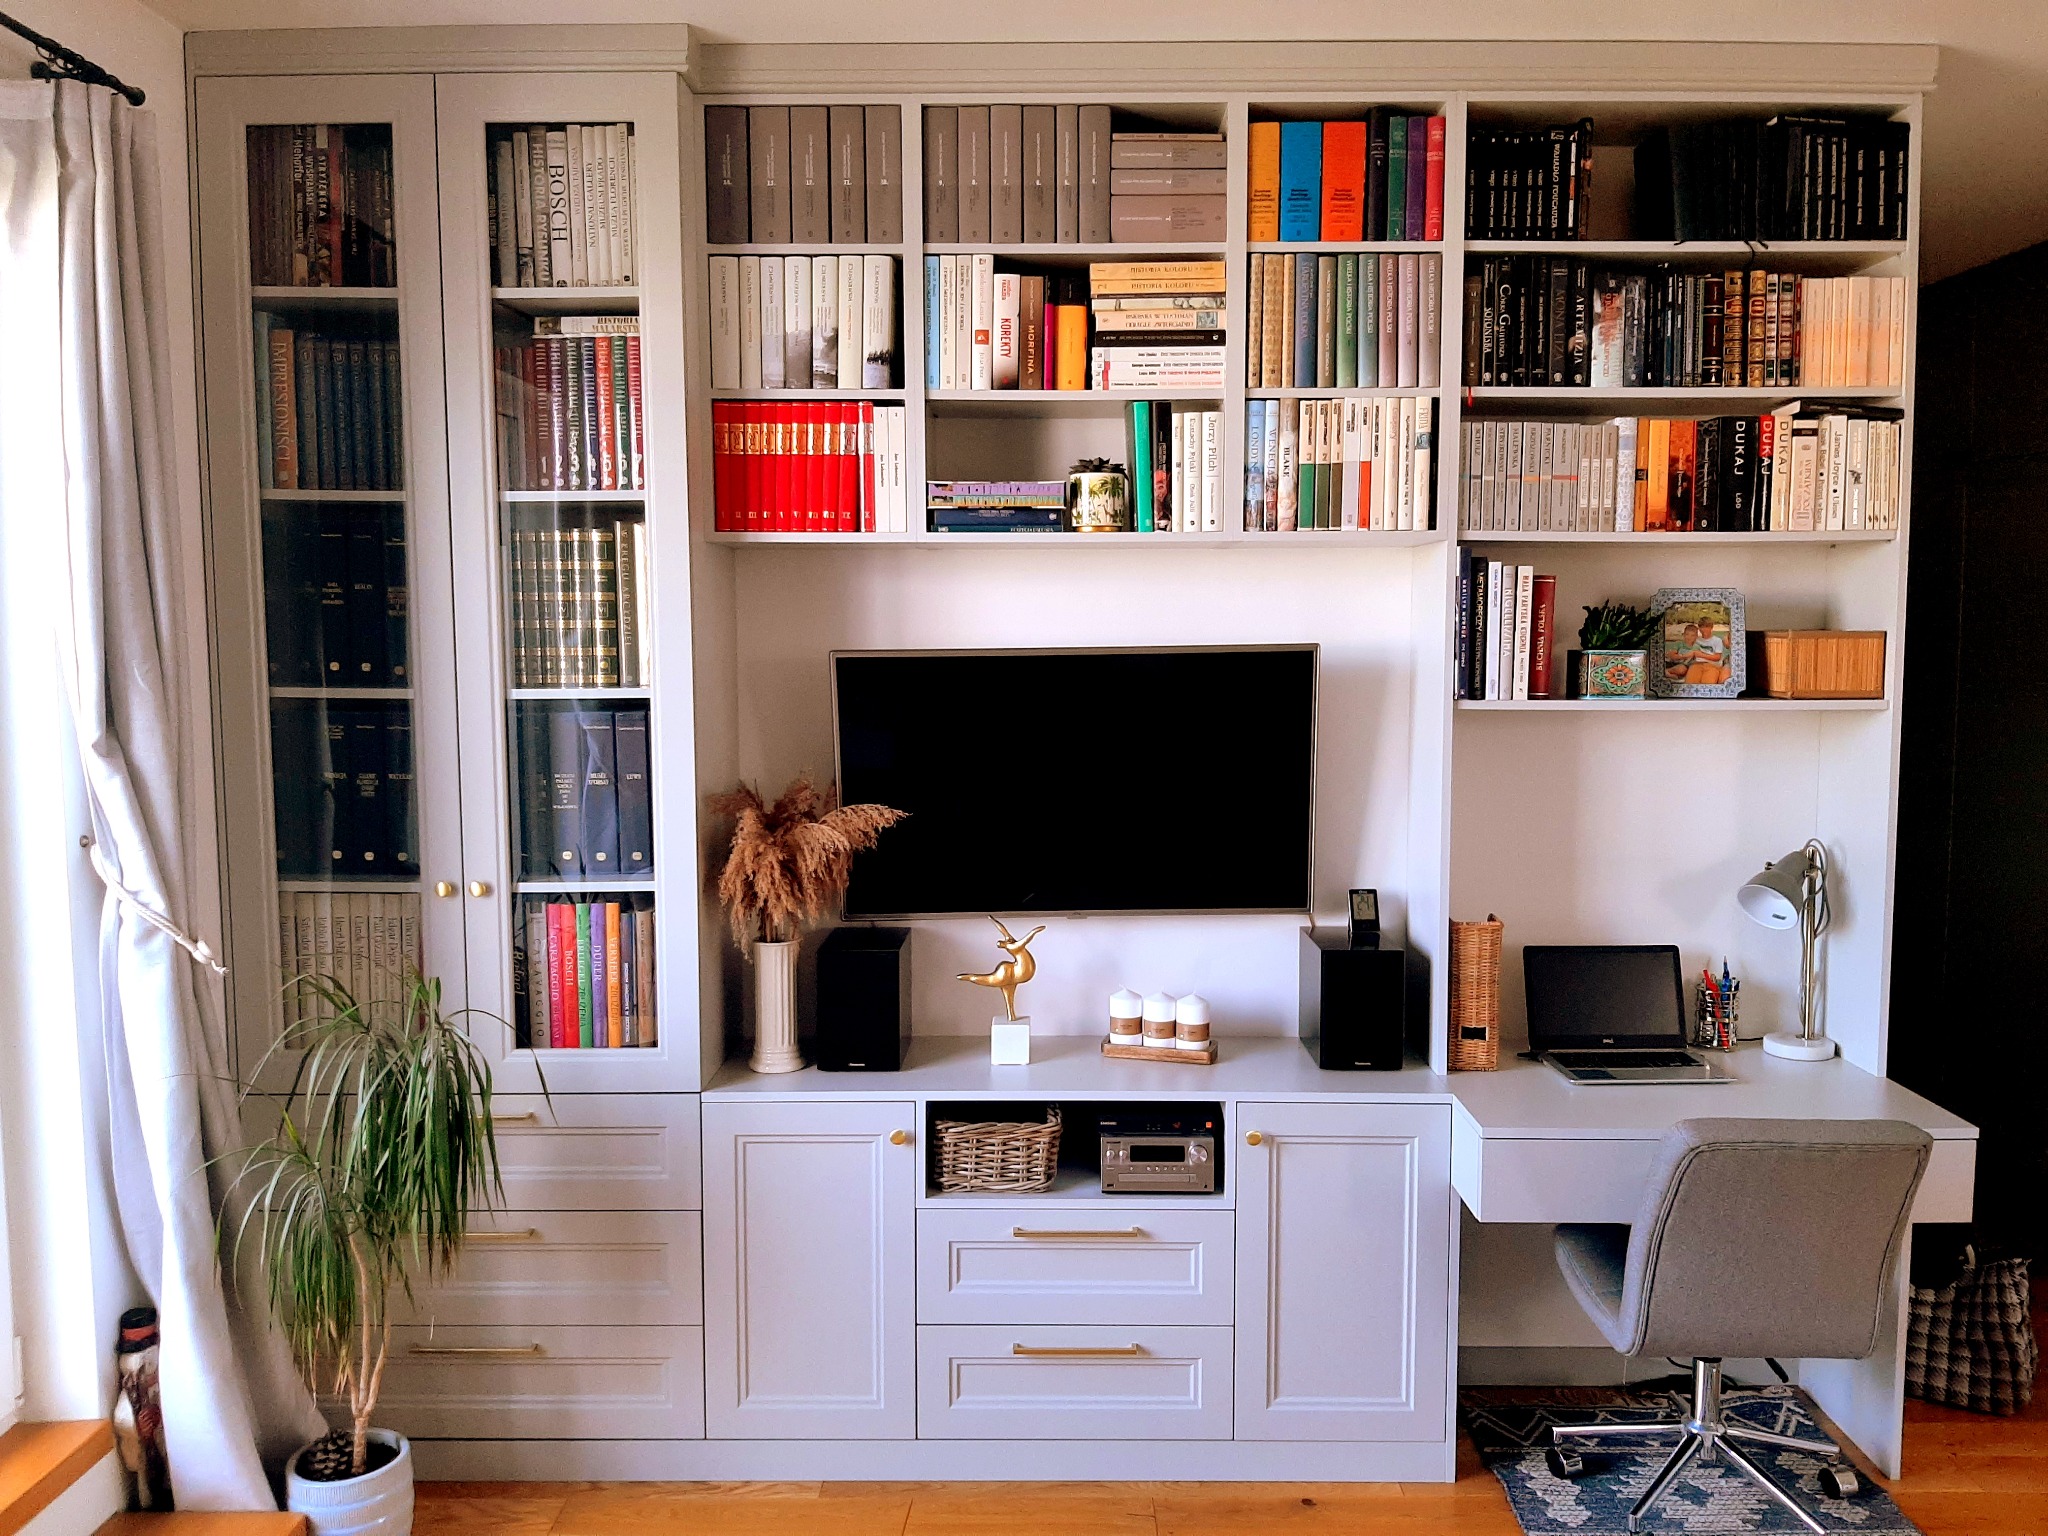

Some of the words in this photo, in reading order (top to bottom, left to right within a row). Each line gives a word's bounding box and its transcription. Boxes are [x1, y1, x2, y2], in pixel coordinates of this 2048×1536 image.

[532, 143, 546, 208] HISTORIA
[585, 161, 594, 202] GALLERY
[609, 157, 617, 204] FLORENCJI
[549, 164, 568, 242] BOSCH
[598, 190, 606, 229] MUZEUM
[610, 206, 618, 238] MUZEA
[588, 205, 596, 248] NATIONAL
[536, 215, 550, 281] RYSUNKU
[1554, 288, 1564, 325] MONA
[1000, 318, 1012, 358] KOREKTY
[1027, 324, 1035, 374] MORFINA
[1484, 307, 1494, 353] SOFONISBA
[1554, 333, 1564, 361] LIZA
[1574, 295, 1585, 365] ARTEMIZJA
[1188, 418, 1196, 449] Eustachy
[1206, 416, 1217, 444] Jerzy
[1418, 407, 1429, 430] FRIDA
[1208, 447, 1218, 472] Pilch
[1250, 426, 1260, 469] LONDYN
[1267, 428, 1277, 476] WENECJA
[1474, 428, 1482, 456] SCHULZ
[1543, 428, 1552, 465] PARNICKI
[1734, 421, 1746, 475] DUKAJ
[1761, 420, 1773, 475] DUKAJ
[1778, 421, 1789, 475] DUKAJ
[1833, 430, 1843, 459] James
[542, 456, 547, 474] 1
[1282, 447, 1290, 478] BLAKE
[1831, 460, 1842, 486] Joyce
[1735, 492, 1743, 509] LÓD
[1475, 572, 1484, 632] METAMORFOZY
[1520, 595, 1529, 624] PARYSKA
[1536, 604, 1546, 632] POLSKA
[1519, 627, 1527, 654] KUCHNIA
[1535, 636, 1545, 671] KUCHNIA
[513, 950, 525, 996] Rafael
[549, 934, 560, 1001] CARAVAGGIO
[565, 950, 574, 986] BOSCH
[609, 936, 618, 983] VERMEER
[534, 938, 544, 1037] CARAVAGGIO
